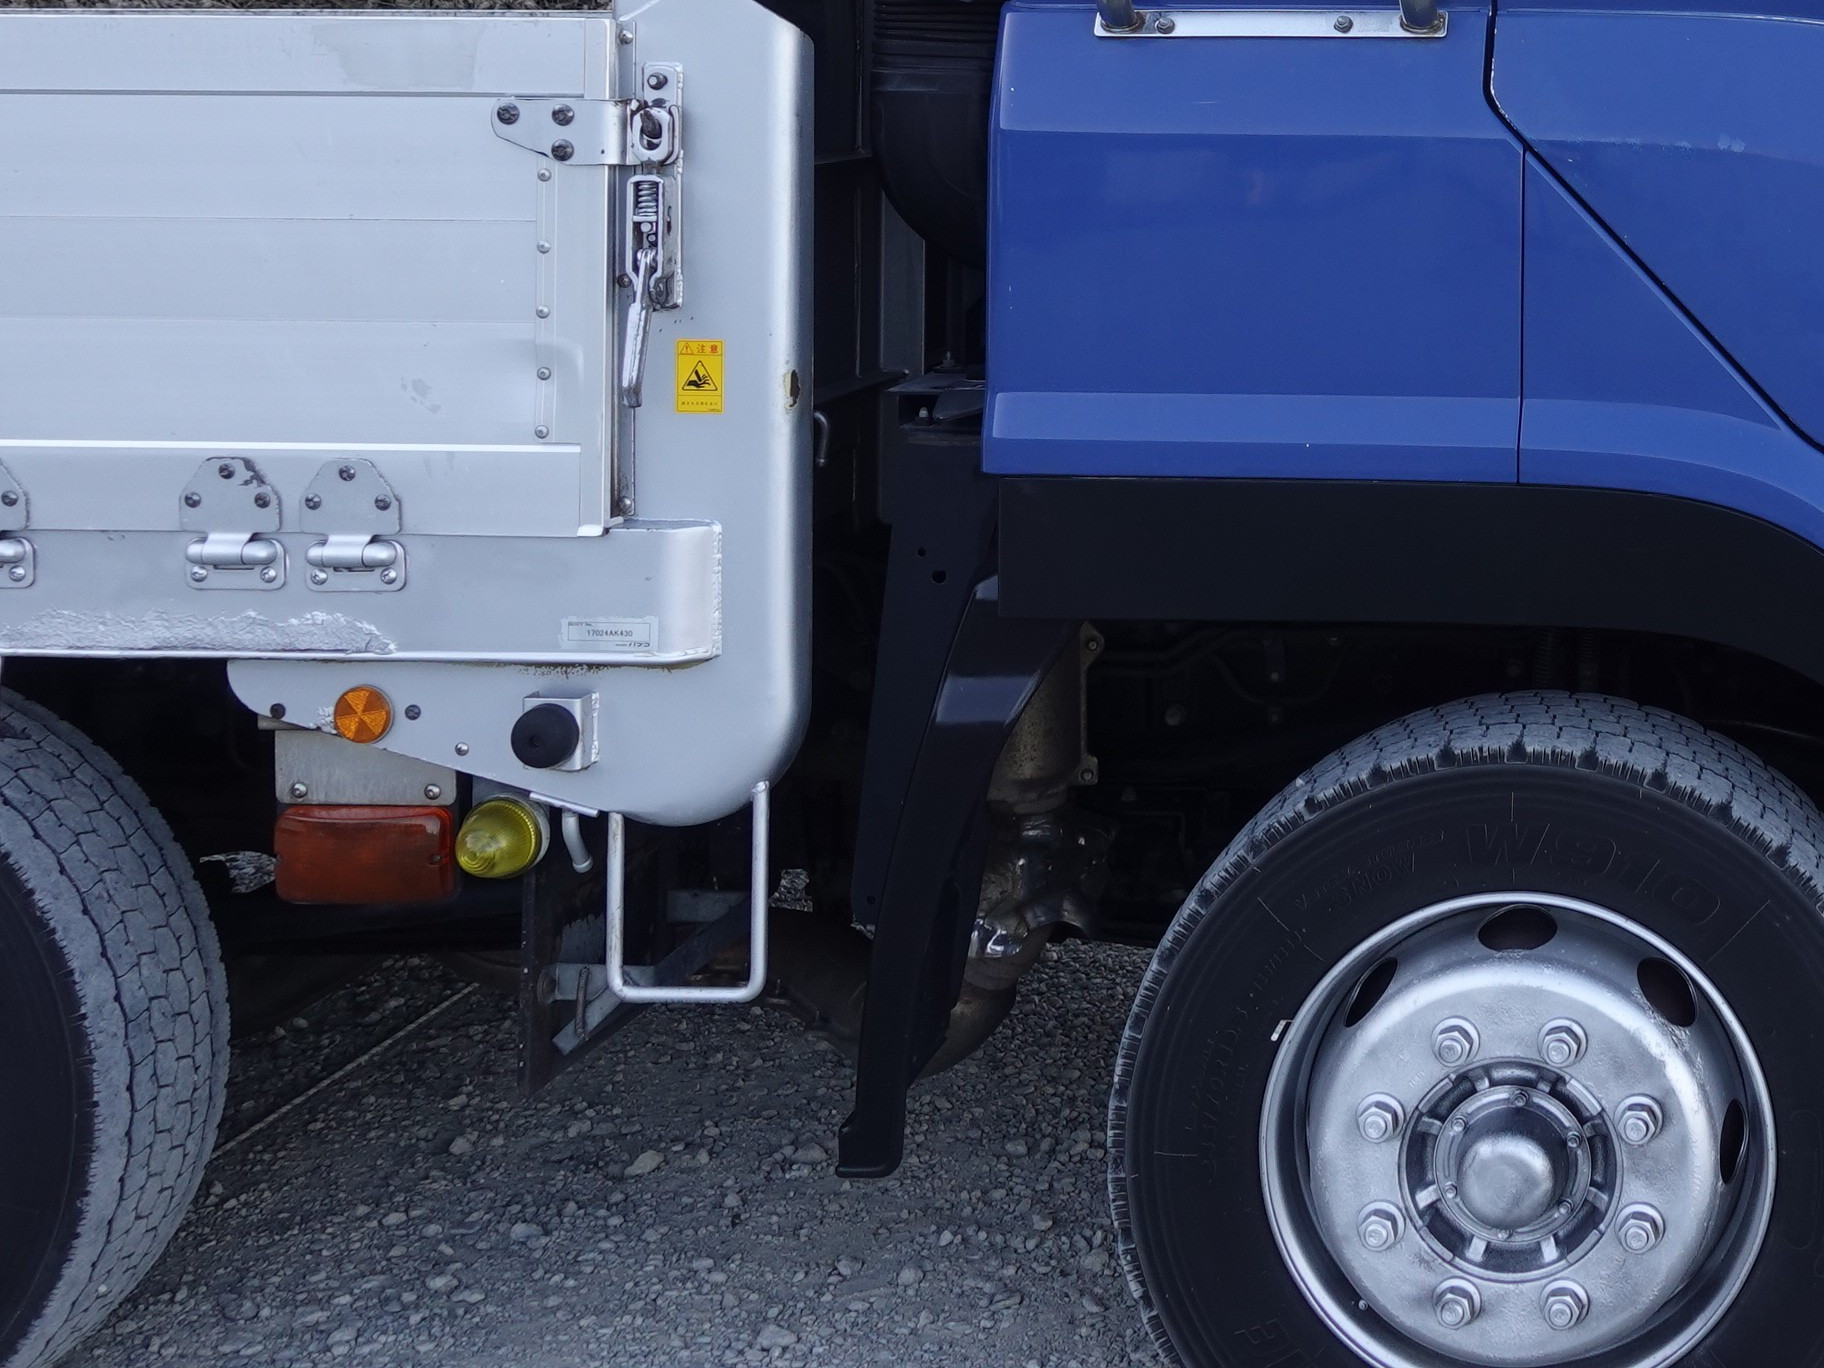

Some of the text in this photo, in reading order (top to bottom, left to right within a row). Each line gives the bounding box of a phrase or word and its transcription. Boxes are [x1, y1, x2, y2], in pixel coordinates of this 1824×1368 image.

[696, 343, 719, 354] 注意
[587, 629, 633, 638] 17024AK430
[1334, 853, 1416, 908] SNOW
[1466, 821, 1721, 927] W910
